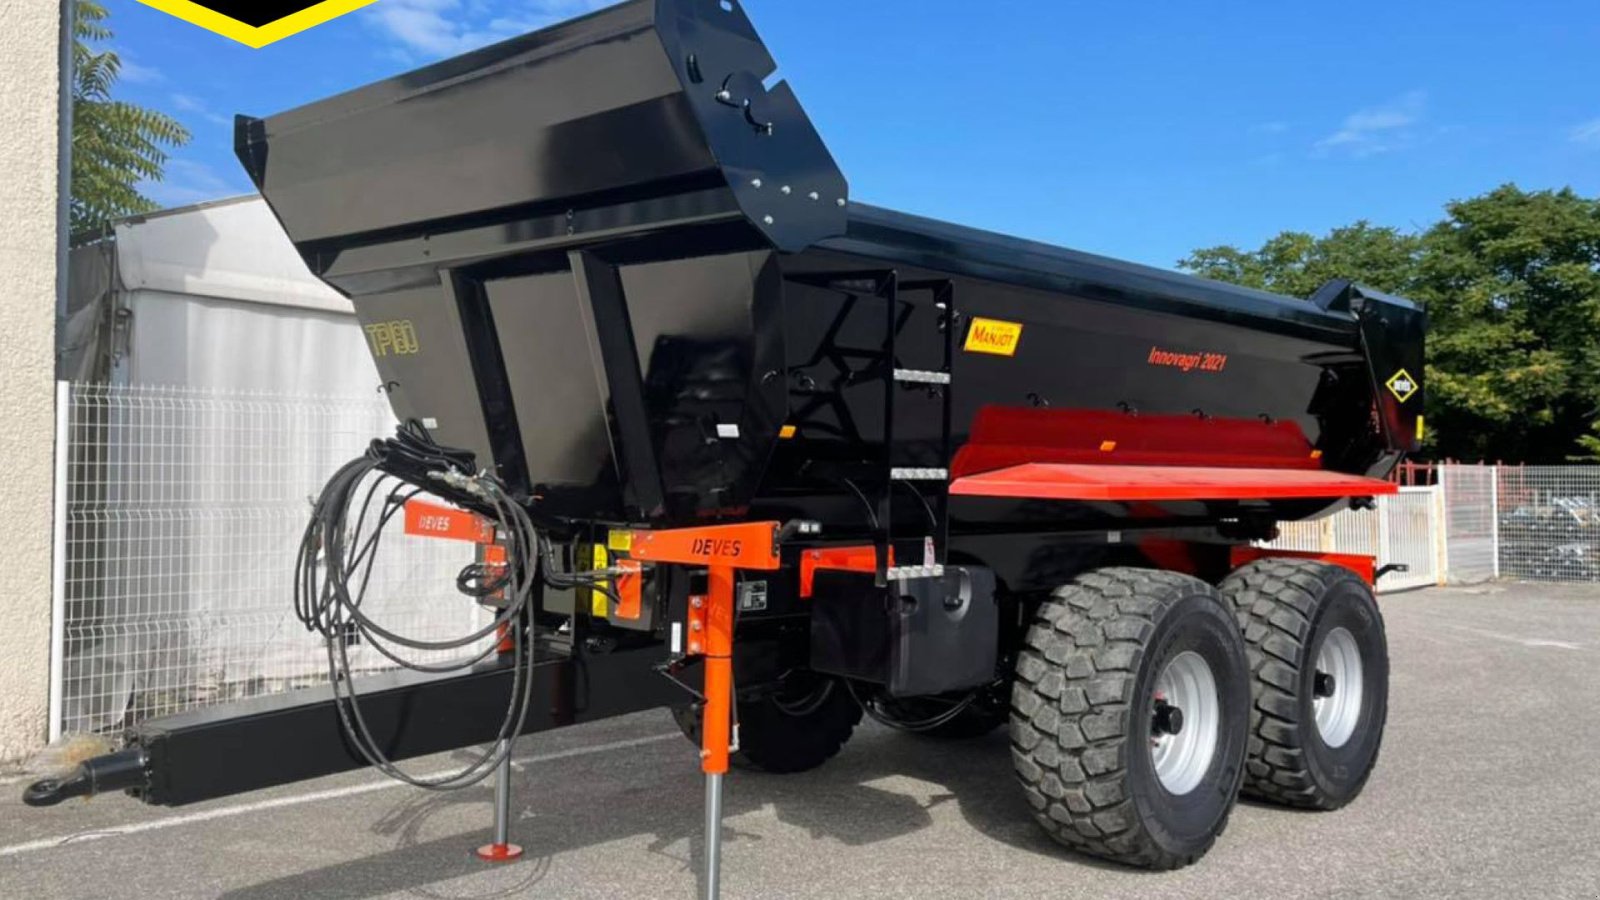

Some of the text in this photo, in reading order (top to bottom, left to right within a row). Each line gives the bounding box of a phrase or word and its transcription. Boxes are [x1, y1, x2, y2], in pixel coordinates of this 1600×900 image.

[1148, 346, 1227, 371] Innovagri 2021
[418, 515, 450, 531] DEVES
[691, 538, 741, 556] DEVES
